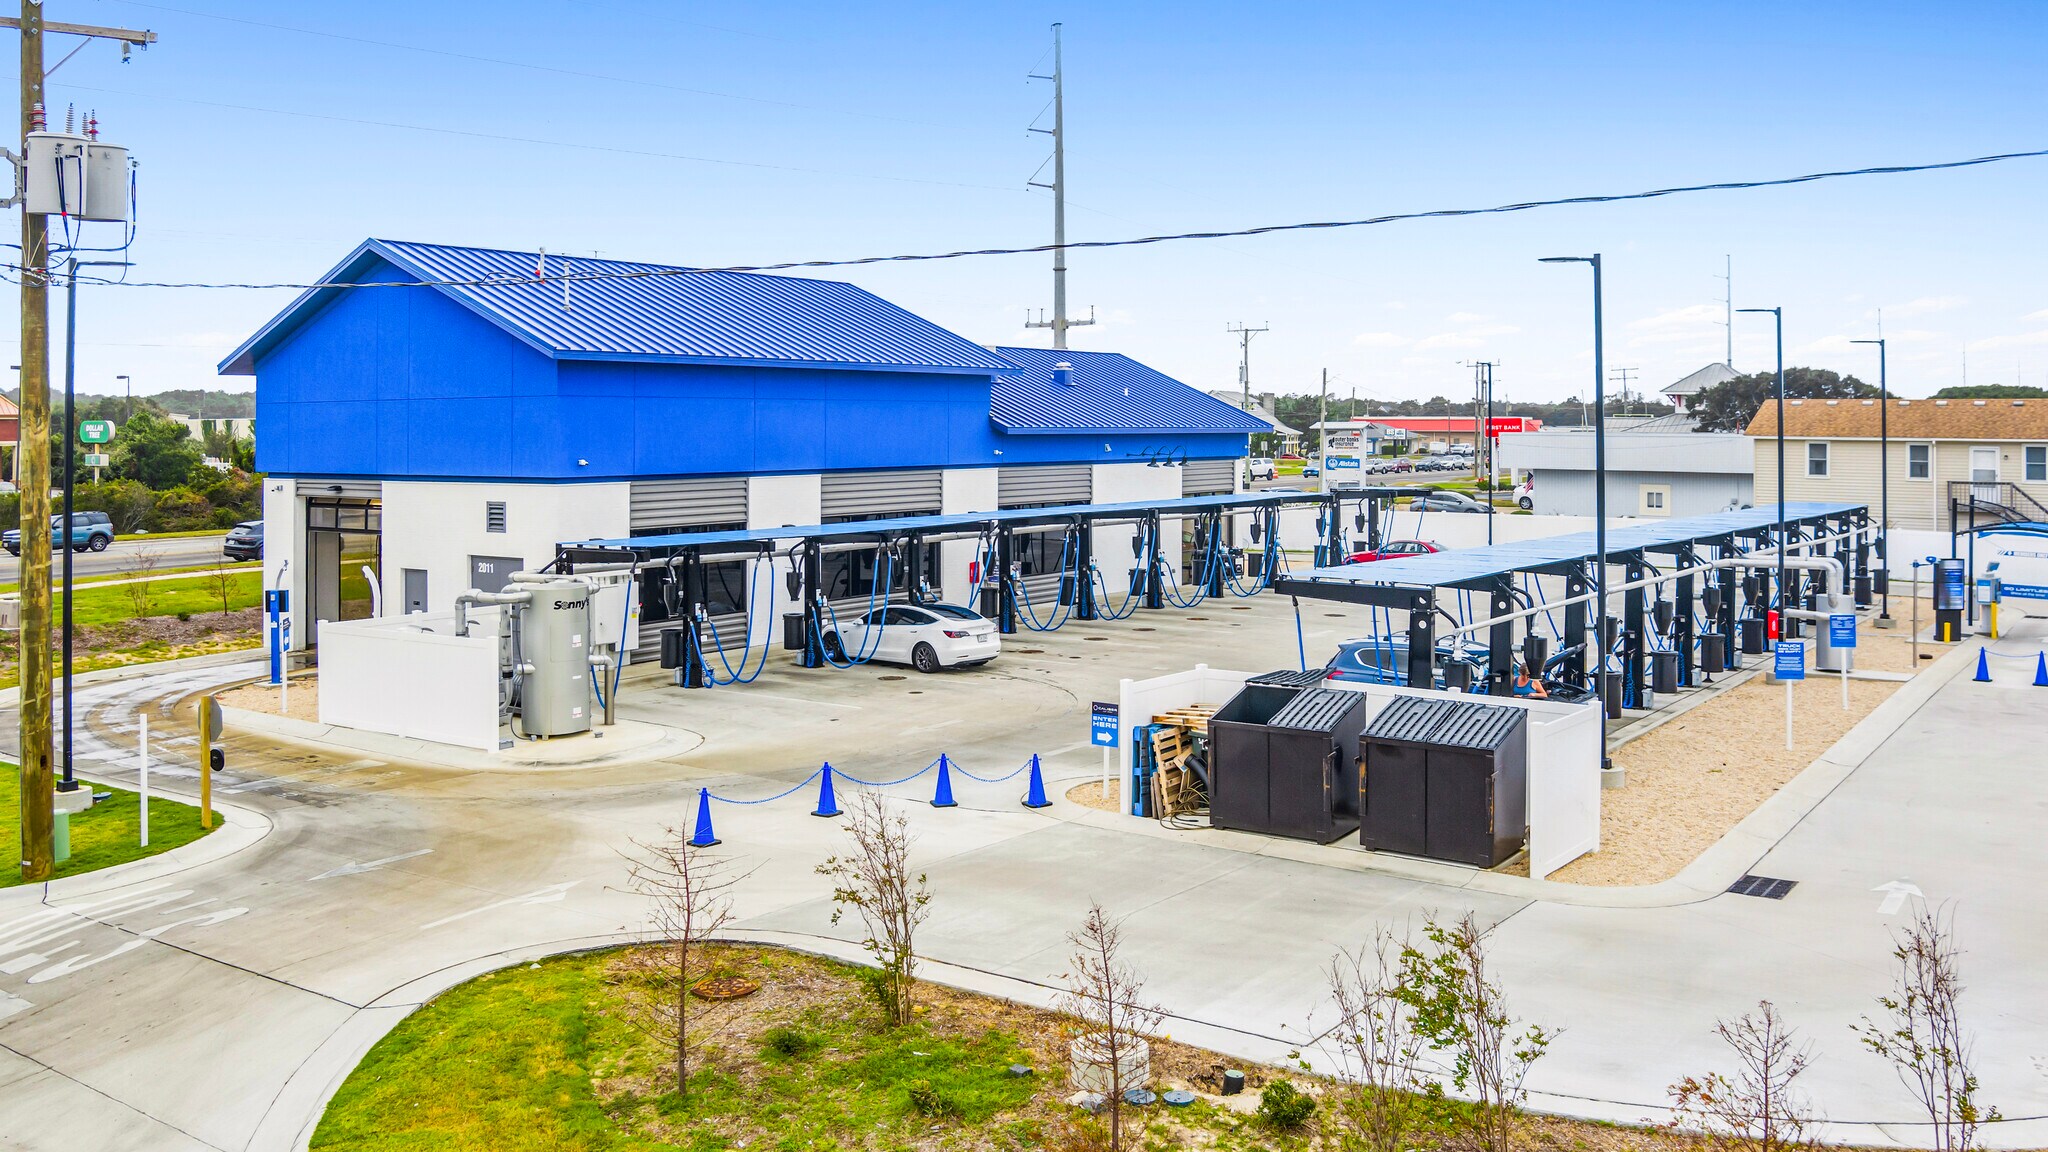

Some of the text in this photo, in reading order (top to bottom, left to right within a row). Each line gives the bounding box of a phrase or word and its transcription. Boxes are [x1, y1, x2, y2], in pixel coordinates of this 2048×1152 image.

[478, 562, 494, 574] 2011
[553, 597, 589, 610] Sonny's
[1092, 715, 1118, 723] ENTER
[1092, 720, 1118, 729] HERE
